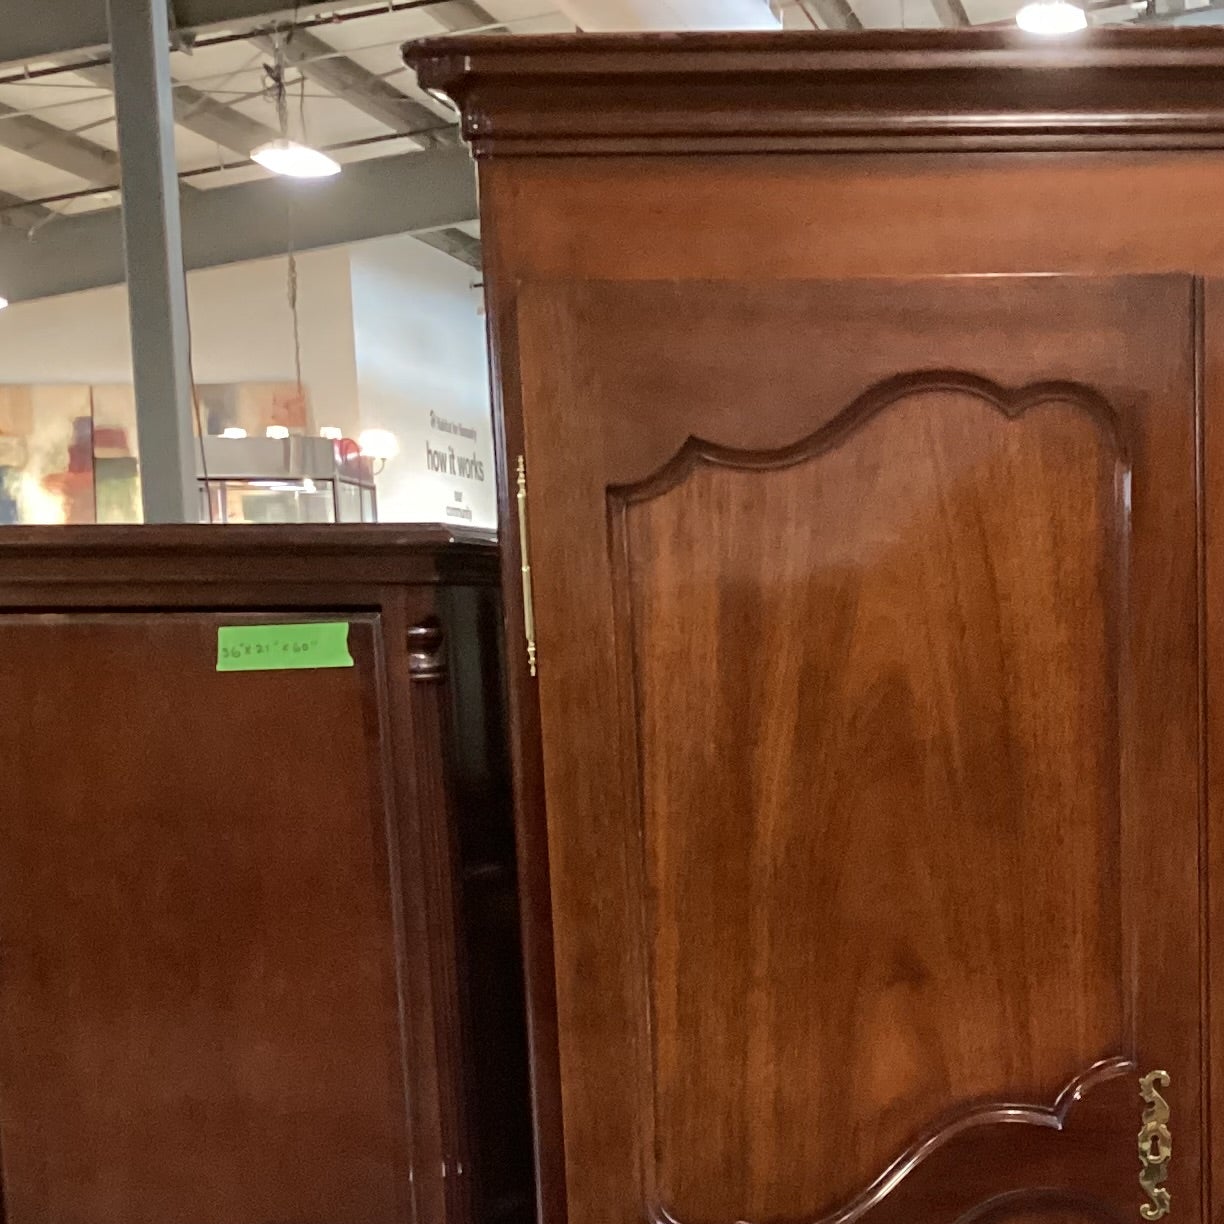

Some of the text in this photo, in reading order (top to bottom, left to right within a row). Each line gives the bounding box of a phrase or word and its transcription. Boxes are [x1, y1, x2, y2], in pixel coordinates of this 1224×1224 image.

[426, 440, 484, 482] how it works
